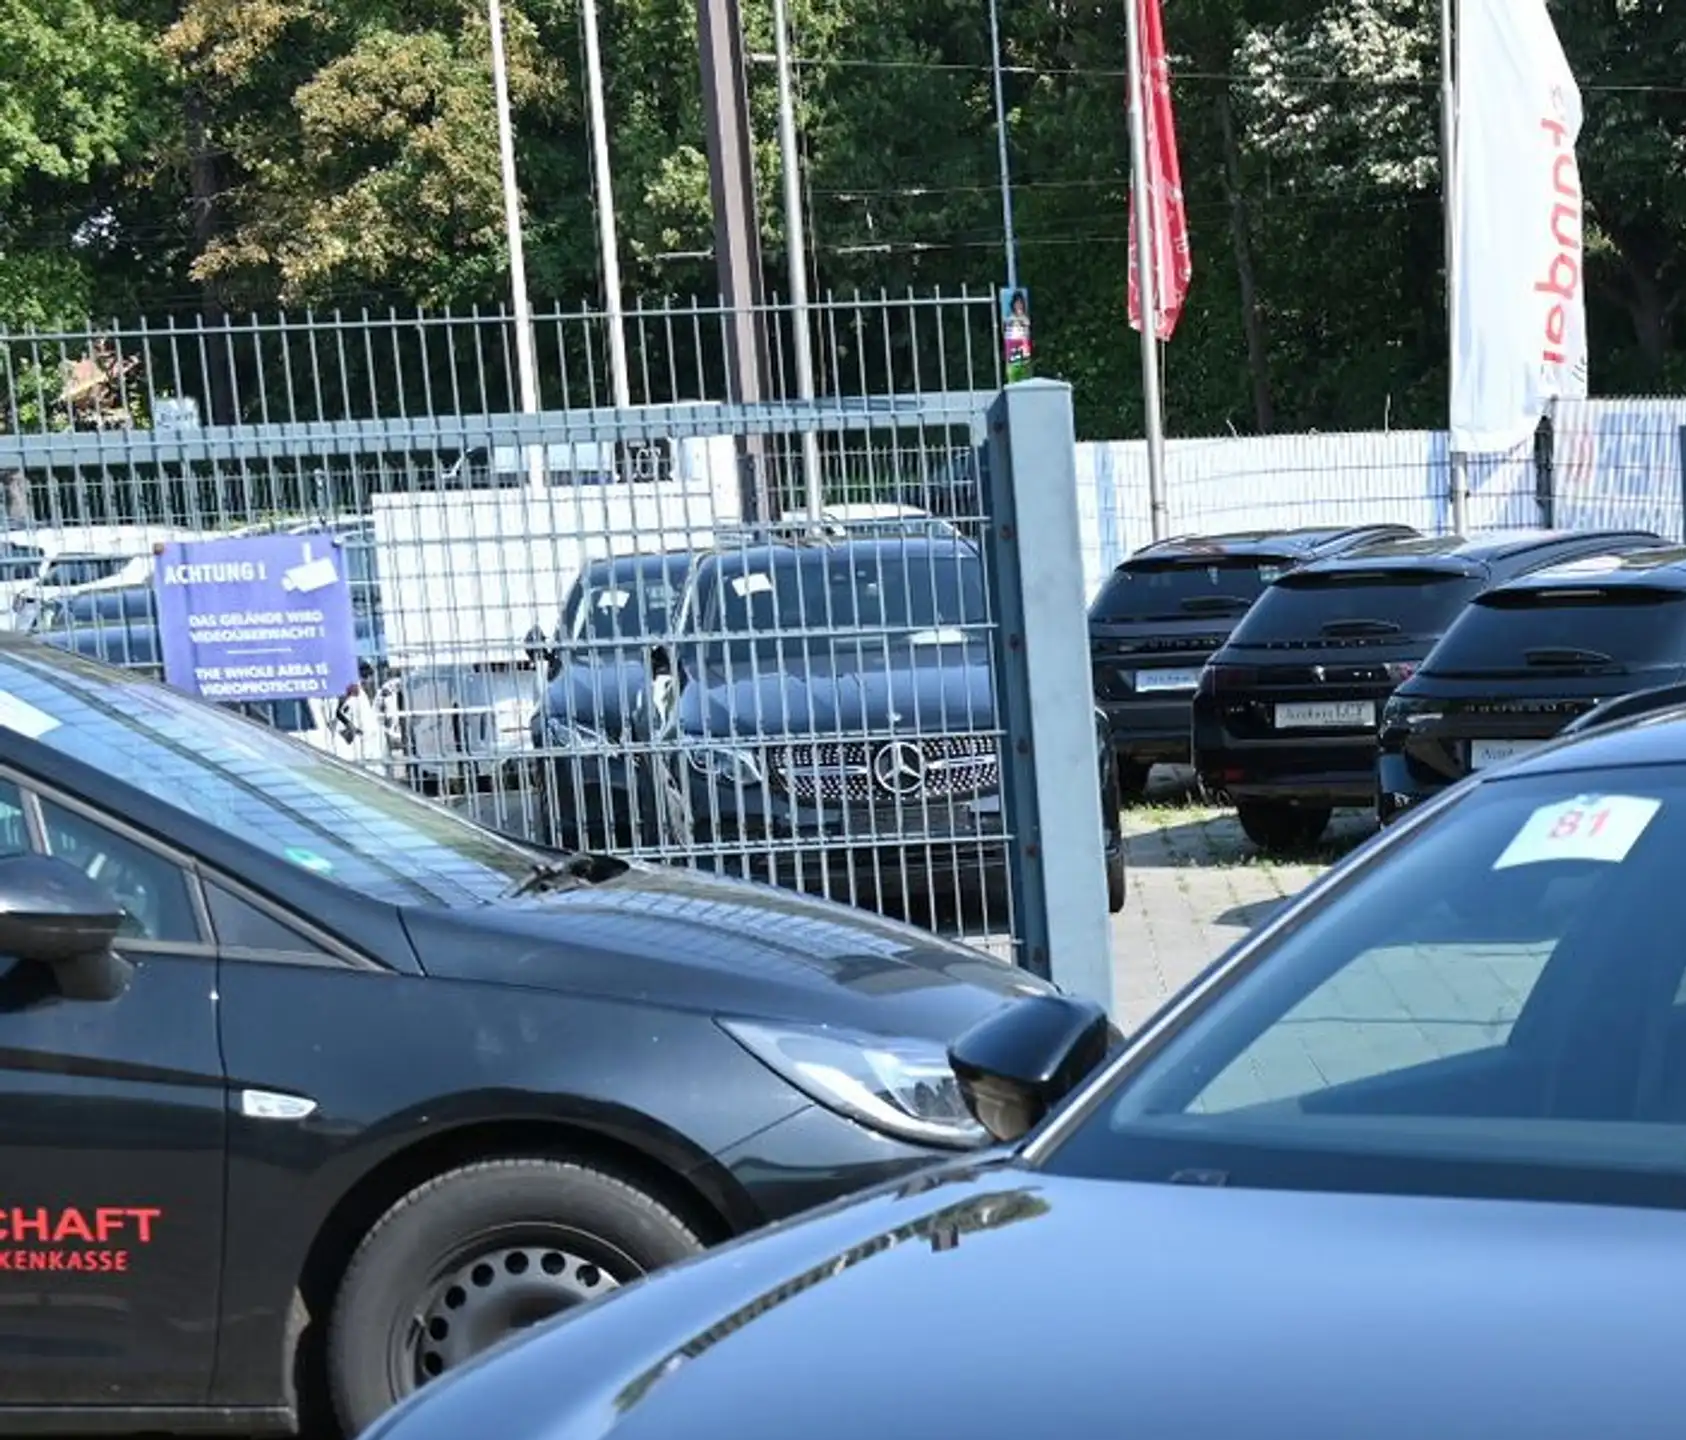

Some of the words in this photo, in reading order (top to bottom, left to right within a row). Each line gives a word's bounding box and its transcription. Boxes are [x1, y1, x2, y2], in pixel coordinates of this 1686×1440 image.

[165, 562, 255, 585] ACHTUNG
[188, 613, 217, 627] DAS
[219, 610, 283, 627] GELÄNDE
[286, 609, 324, 624] WIRD
[195, 666, 220, 681] THE
[223, 664, 275, 679] WHOLE
[278, 663, 313, 677] AREA
[315, 662, 328, 676] IS
[0, 1206, 162, 1243] HAFT
